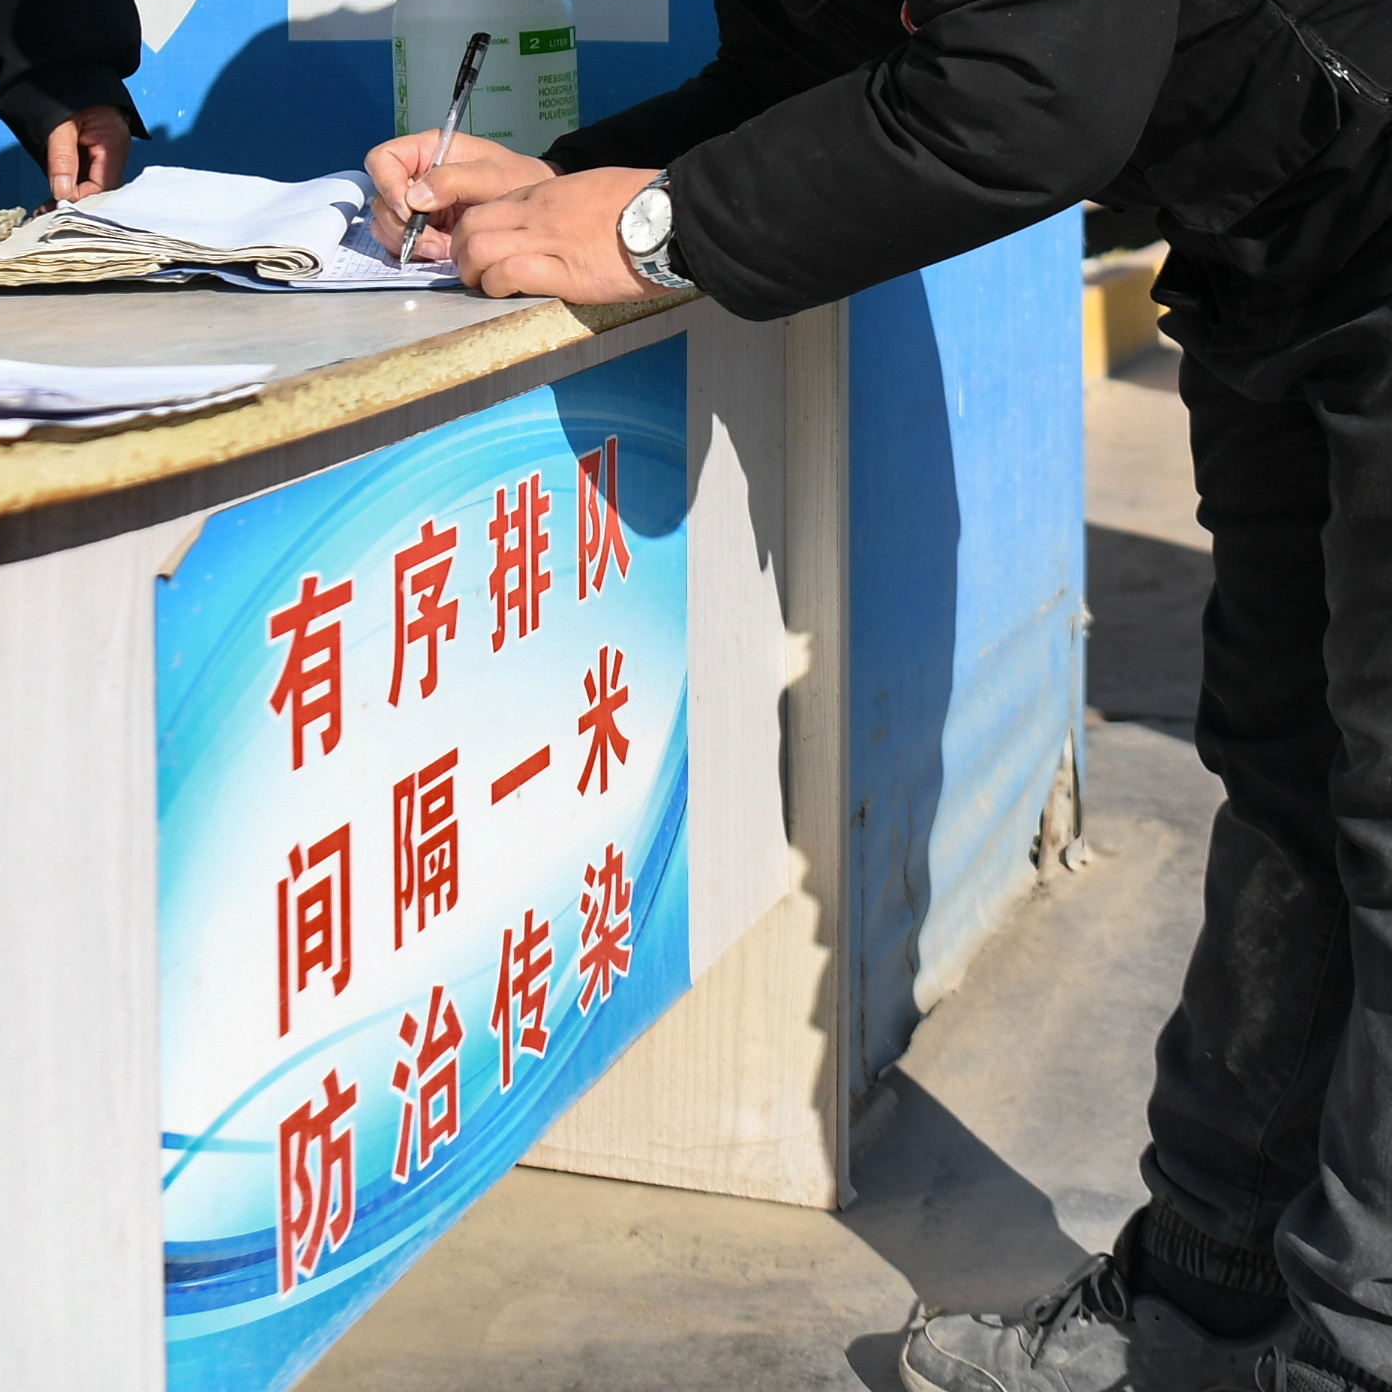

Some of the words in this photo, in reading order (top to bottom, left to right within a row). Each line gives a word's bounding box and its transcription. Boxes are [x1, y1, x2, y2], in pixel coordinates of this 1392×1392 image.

[488, 130, 513, 139] 1000ML
[528, 37, 540, 49] 2
[549, 38, 569, 48] LITER
[268, 436, 631, 772] 有序排队
[276, 646, 631, 1038] 间隔一米
[278, 843, 633, 1294] 防治传染
